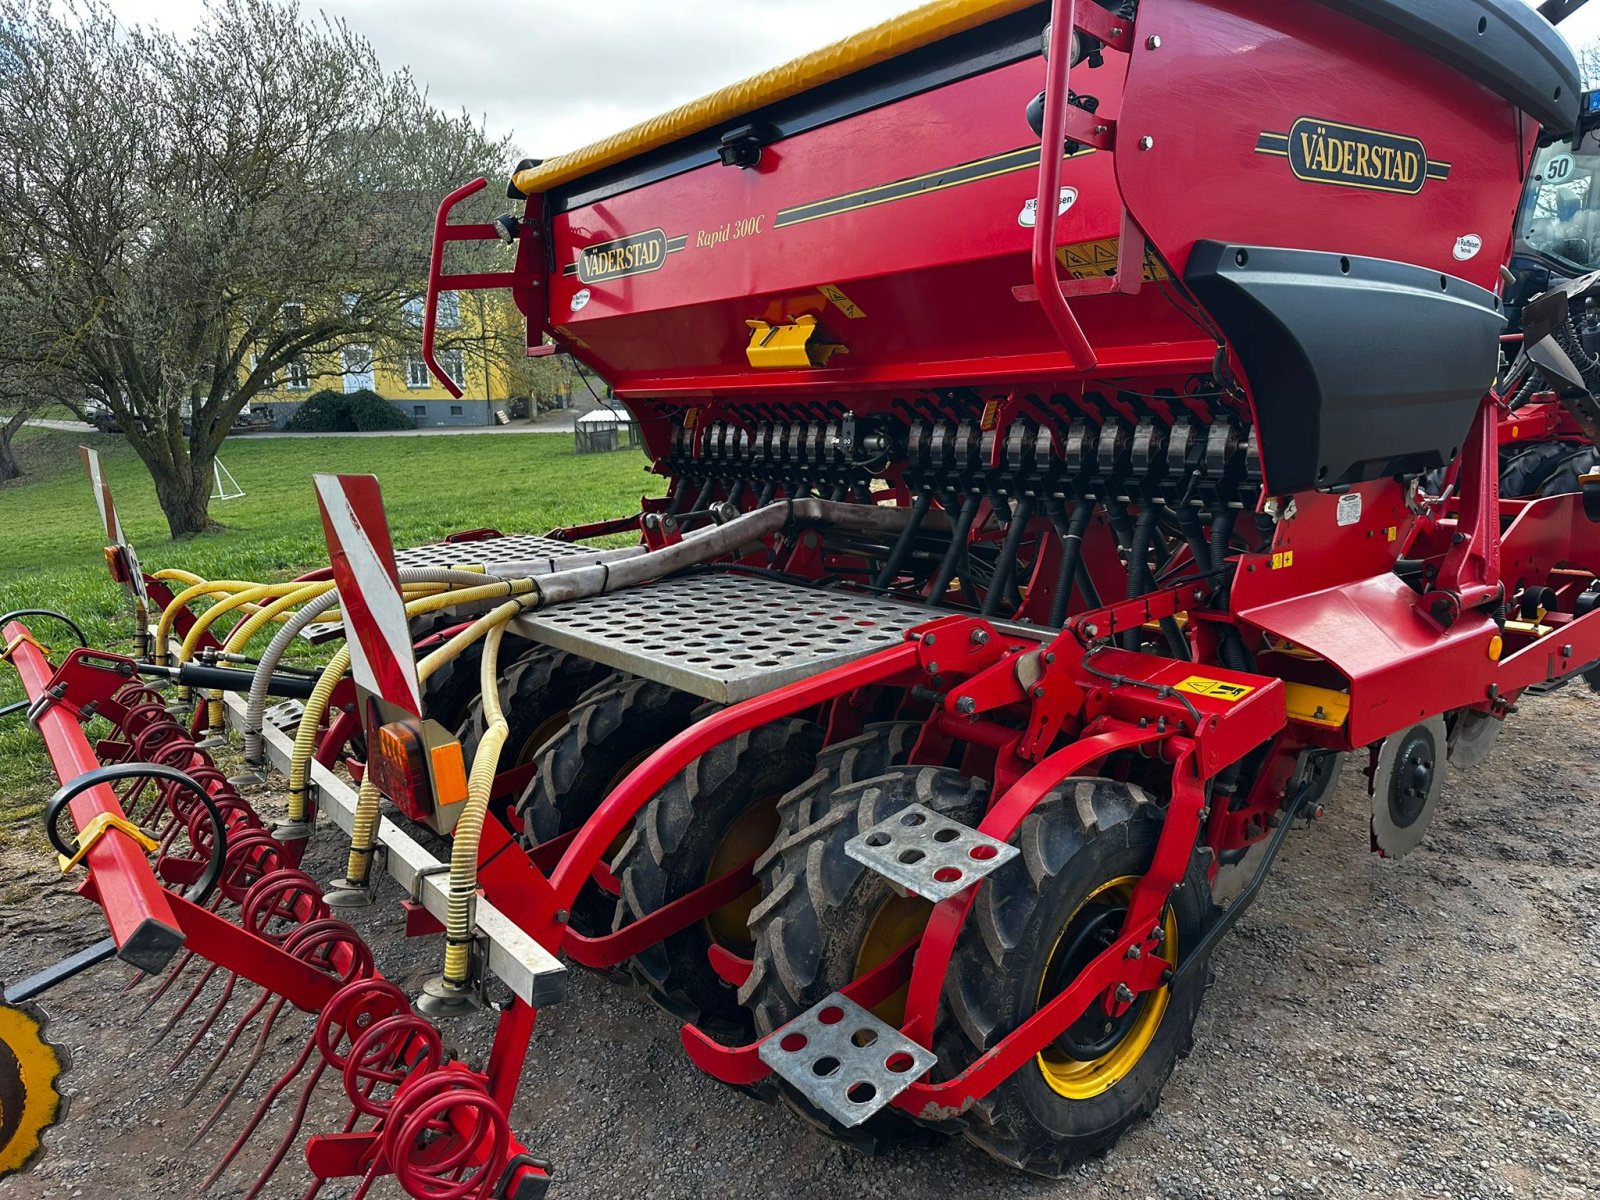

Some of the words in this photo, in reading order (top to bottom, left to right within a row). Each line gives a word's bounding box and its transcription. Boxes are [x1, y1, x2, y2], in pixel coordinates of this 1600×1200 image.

[1300, 126, 1419, 184] VÄDERSTAD
[1547, 157, 1569, 180] 50
[696, 223, 731, 249] Rapid
[733, 214, 766, 240] 300C
[583, 239, 661, 278] VÄDERSTAD
